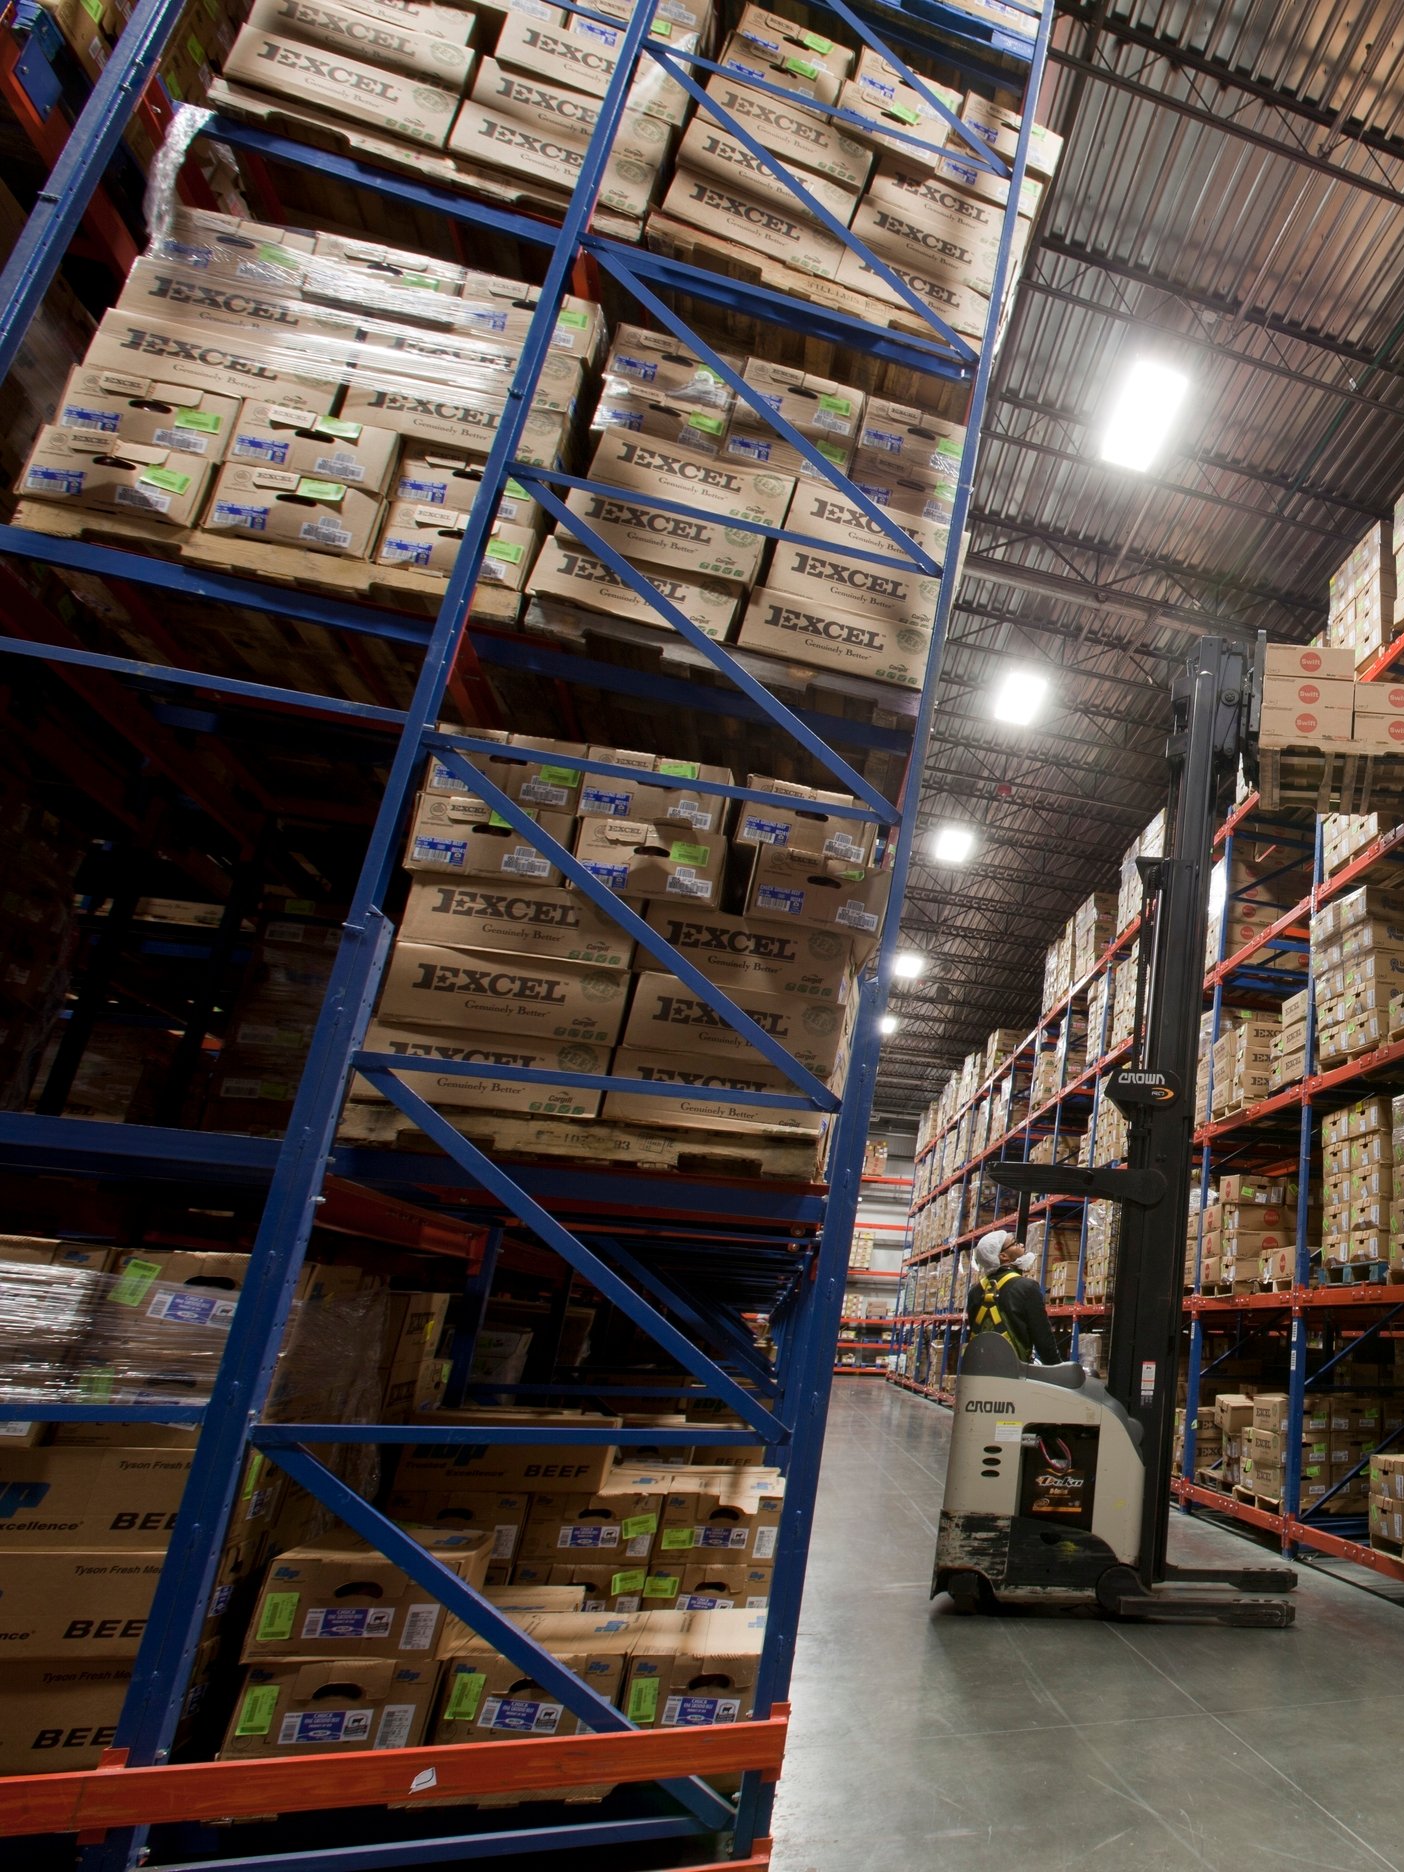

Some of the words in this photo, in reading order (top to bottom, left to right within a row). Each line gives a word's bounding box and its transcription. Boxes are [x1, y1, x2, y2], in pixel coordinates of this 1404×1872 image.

[277, 0, 416, 57] EXCEL
[522, 27, 616, 75] EXCE
[257, 40, 399, 102] EXCEL
[496, 77, 600, 127] EXCE
[721, 91, 829, 148] EXCEL
[478, 118, 584, 167] EXCE
[891, 171, 990, 225] EXCEL
[689, 183, 801, 241] EXCEL
[873, 210, 973, 265] EXCEL
[148, 275, 300, 326] EXCEL
[119, 327, 278, 381] EXCEL
[173, 363, 222, 383] Genuinely
[413, 418, 459, 436] Genuinely
[461, 428, 490, 442] Better
[617, 442, 742, 493] EXCEL
[659, 477, 699, 494] Genuinely
[702, 488, 727, 500] Better
[585, 497, 712, 545] EXCEL
[627, 530, 667, 548] Genuinely
[670, 542, 696, 554] Better
[848, 532, 884, 550] Genuinely
[791, 552, 907, 601] EXCEL
[600, 588, 640, 606] Genuinely
[830, 586, 867, 604] Genuinely
[870, 597, 893, 609] Better
[764, 604, 884, 651] EXCEL
[805, 638, 842, 656] Genuinely
[845, 648, 869, 660] Better
[1302, 658, 1321, 666] Swift
[1300, 690, 1319, 698] Swift
[1297, 719, 1316, 727] Swift
[451, 804, 487, 814] EXCEL
[608, 825, 642, 835] EXCEL
[431, 888, 581, 928] EXCEL
[482, 923, 530, 939] Genuinely
[533, 930, 562, 942] Better
[666, 920, 795, 961] EXCEL
[707, 955, 751, 972] Genuinely
[753, 962, 780, 974] Better
[412, 963, 567, 1005] EXCEL
[464, 1000, 514, 1017] Genuinely
[518, 1006, 547, 1018] Better
[699, 1032, 746, 1048] Genuinely
[436, 1077, 487, 1093] Genuinely
[491, 1082, 523, 1095] Better
[680, 1102, 726, 1117] Genuinely
[729, 1107, 757, 1119] Better
[119, 1460, 150, 1471] Tyson
[153, 1461, 182, 1470] Fresh
[523, 1464, 590, 1478] BEEF
[0, 1521, 80, 1531] xcellence
[109, 1512, 179, 1531] BEE
[75, 1565, 107, 1575] Tyson
[109, 1565, 141, 1575] Fresh
[62, 1619, 149, 1640] BEE
[42, 1672, 76, 1684] Tyson
[79, 1671, 111, 1681] Fresh
[31, 1726, 117, 1749] BEE
